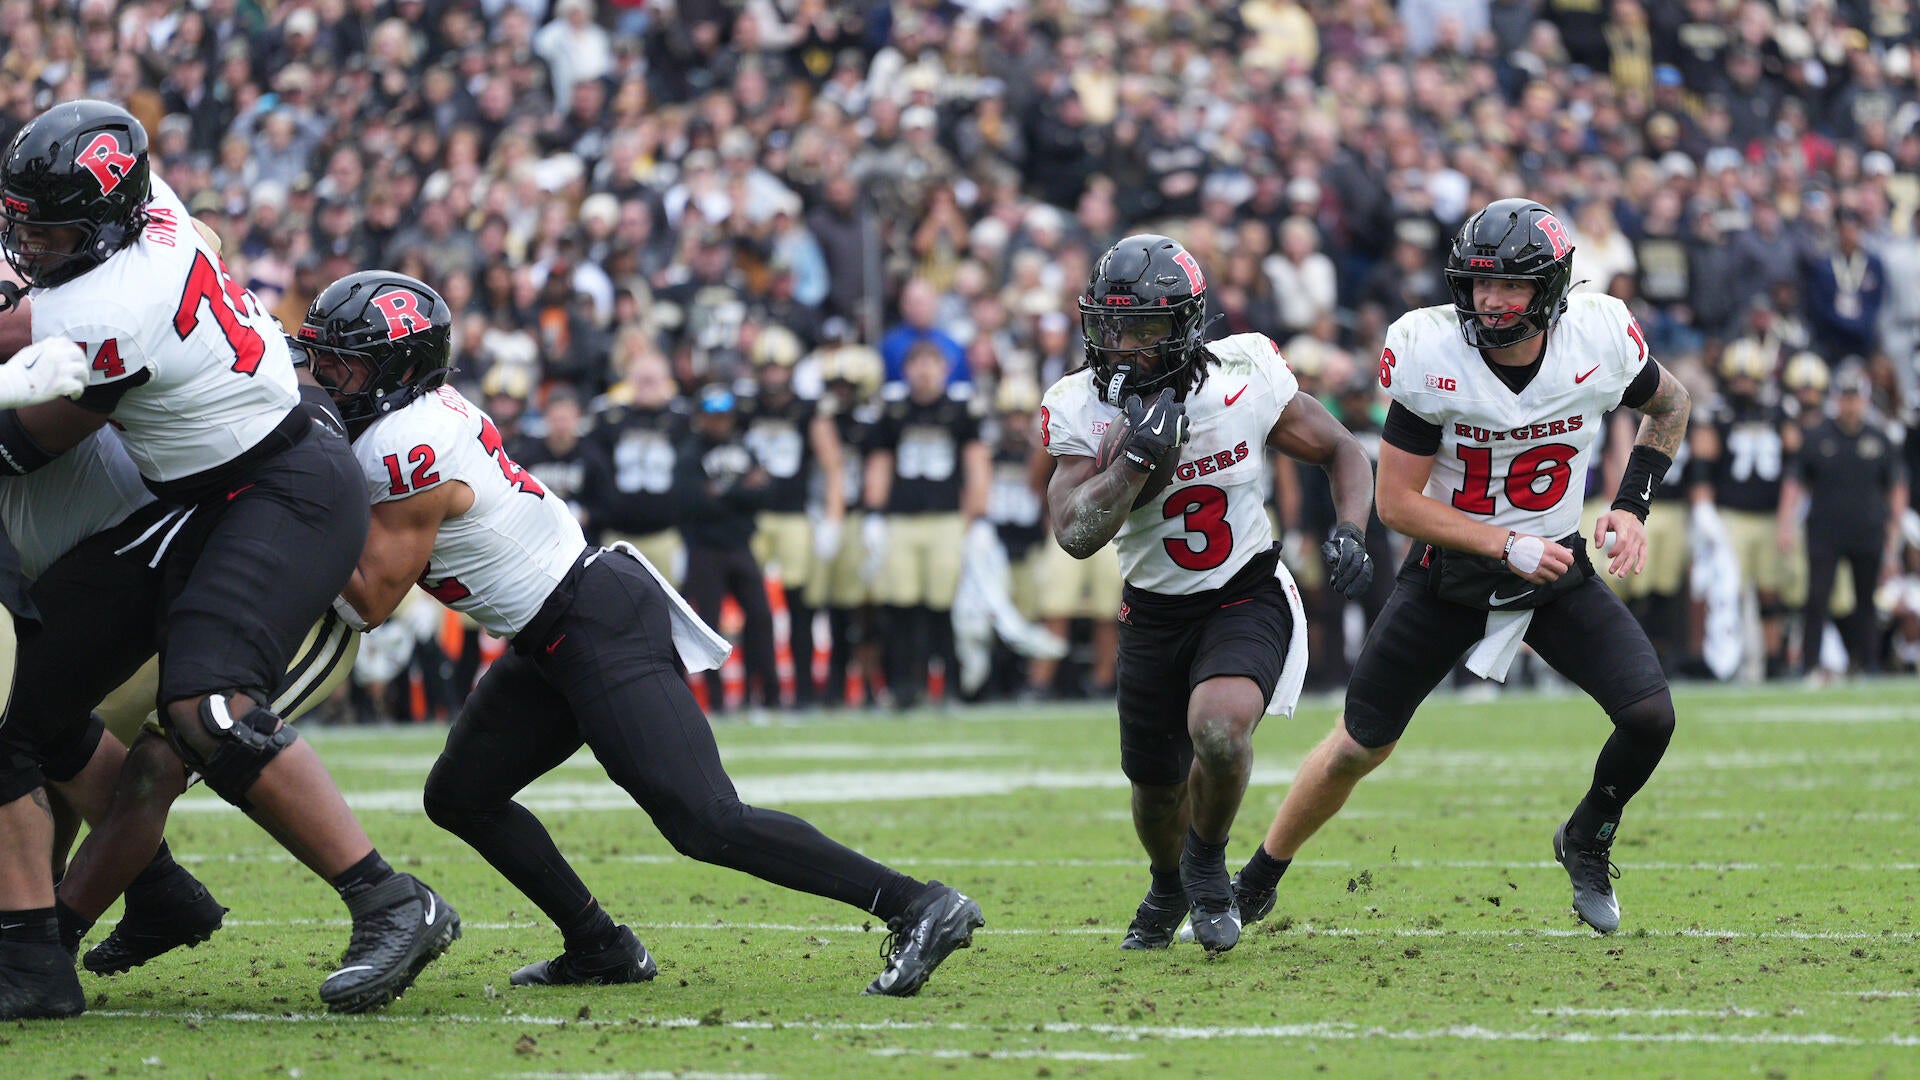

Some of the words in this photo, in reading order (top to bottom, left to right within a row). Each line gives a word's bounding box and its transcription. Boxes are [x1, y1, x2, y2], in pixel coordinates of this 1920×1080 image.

[76, 133, 136, 197] R
[1535, 214, 1573, 261] R
[1172, 250, 1207, 297] R
[370, 290, 432, 342] R
[1454, 414, 1583, 443] RUTGERS
[383, 443, 440, 496] 12
[1168, 440, 1249, 485] GERS
[1451, 442, 1579, 517] 16
[1162, 484, 1234, 571] 3
